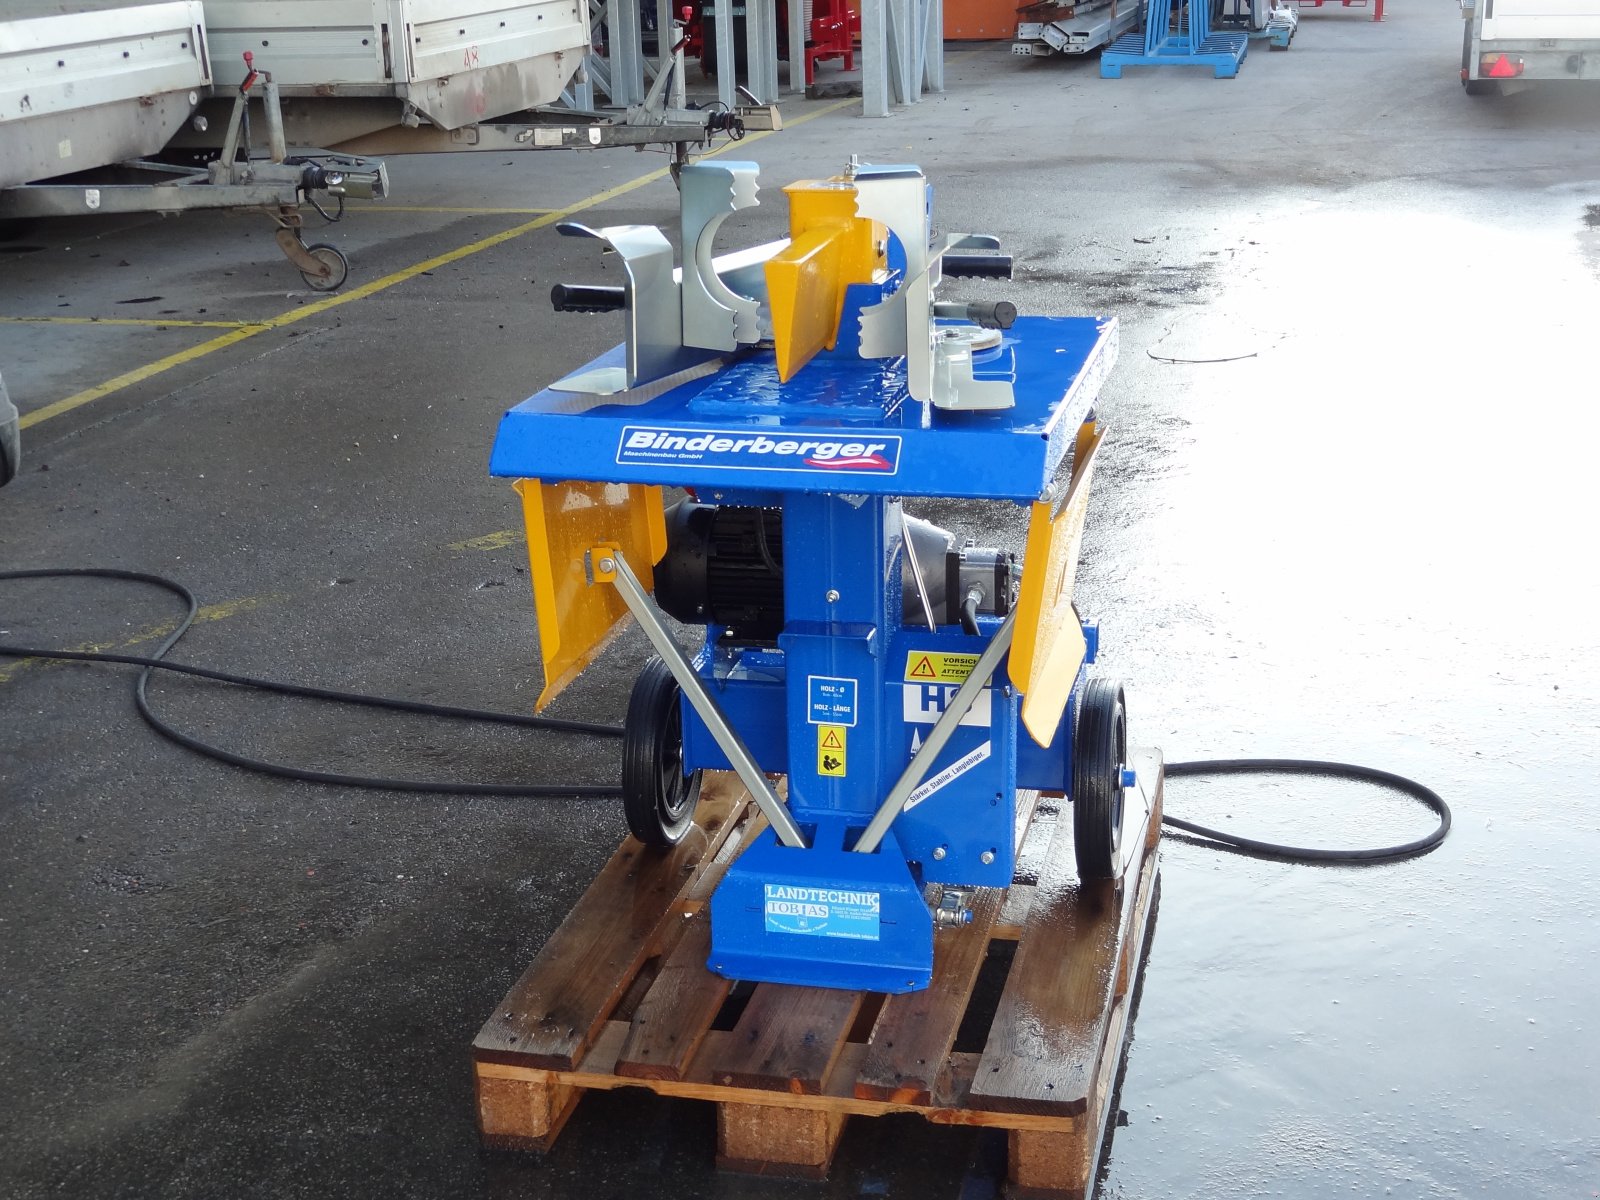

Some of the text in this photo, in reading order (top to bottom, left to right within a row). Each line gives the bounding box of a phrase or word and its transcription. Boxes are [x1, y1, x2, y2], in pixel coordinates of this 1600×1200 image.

[625, 430, 886, 459] Binderberger
[623, 450, 677, 459] Maschinenbau
[909, 752, 985, 803] Stärker. Stabiler. Langlebiger.
[767, 886, 877, 905] LANDTECHNIK
[768, 901, 827, 917] TOBIAS
